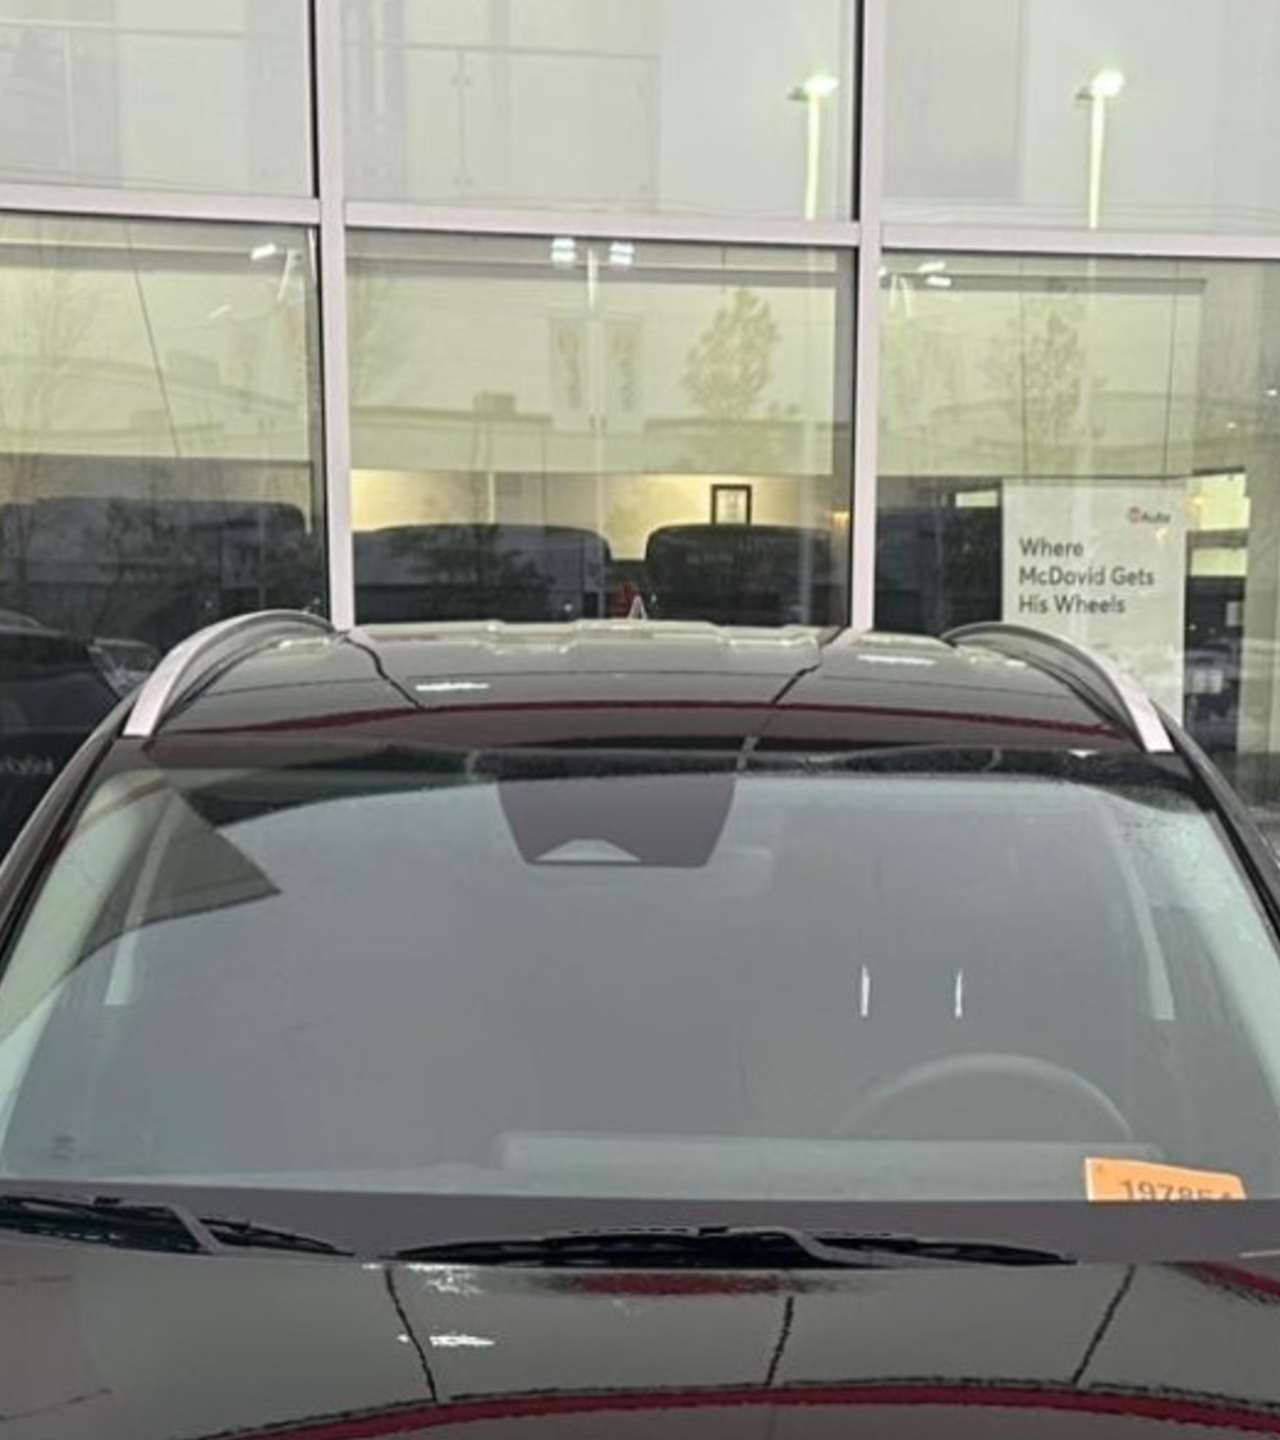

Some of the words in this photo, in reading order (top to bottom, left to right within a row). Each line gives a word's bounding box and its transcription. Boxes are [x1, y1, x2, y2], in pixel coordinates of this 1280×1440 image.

[1019, 539, 1084, 557] Where
[1019, 567, 1106, 586] McDavid
[1111, 567, 1154, 586] Gets
[1019, 595, 1048, 613] His
[1054, 594, 1126, 613] Wheels
